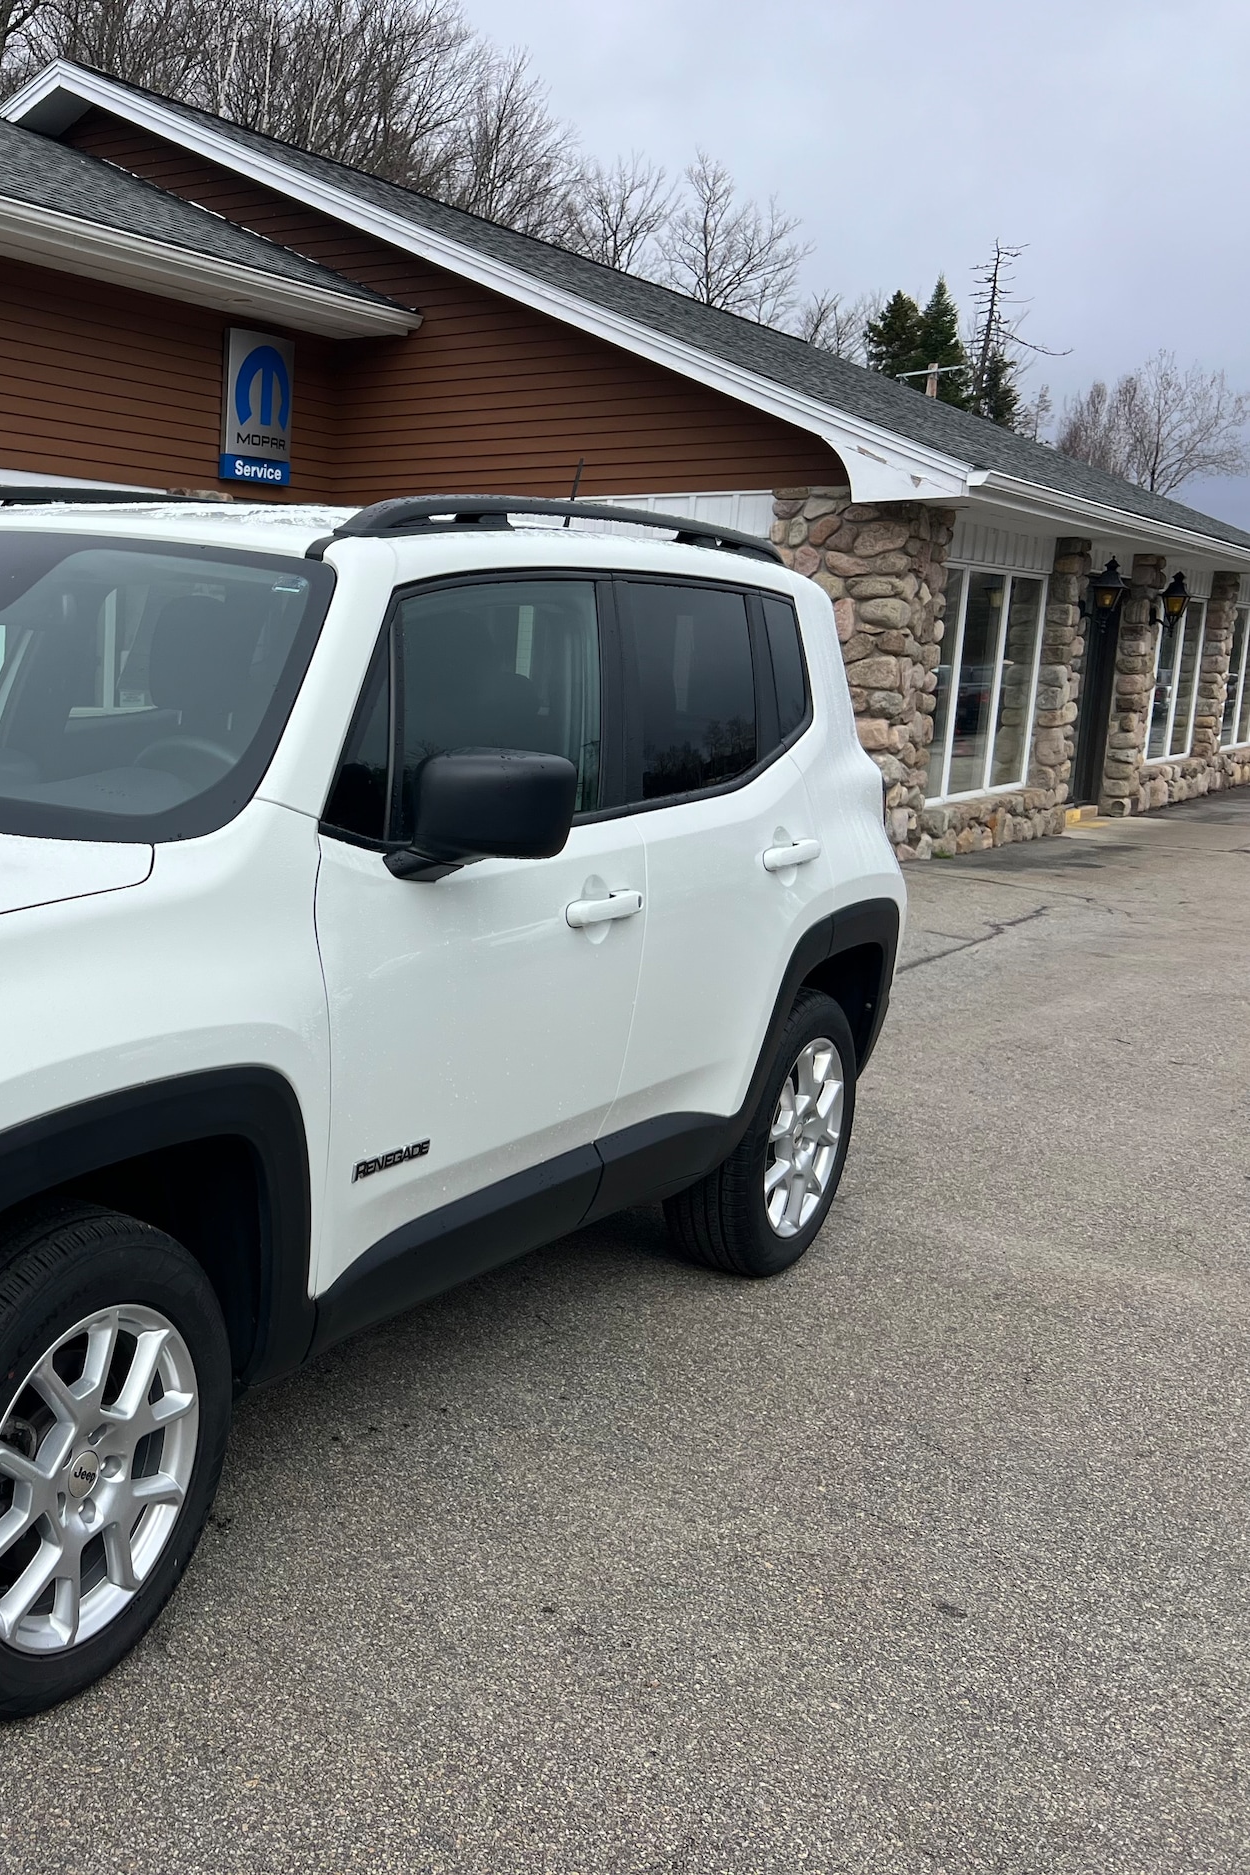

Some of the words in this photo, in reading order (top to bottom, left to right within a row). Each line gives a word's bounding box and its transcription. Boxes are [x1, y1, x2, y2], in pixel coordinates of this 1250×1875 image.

[236, 432, 287, 450] MOPAR
[234, 459, 282, 481] Service
[351, 1137, 431, 1184] RENEGADE
[74, 1466, 96, 1484] Jeep
